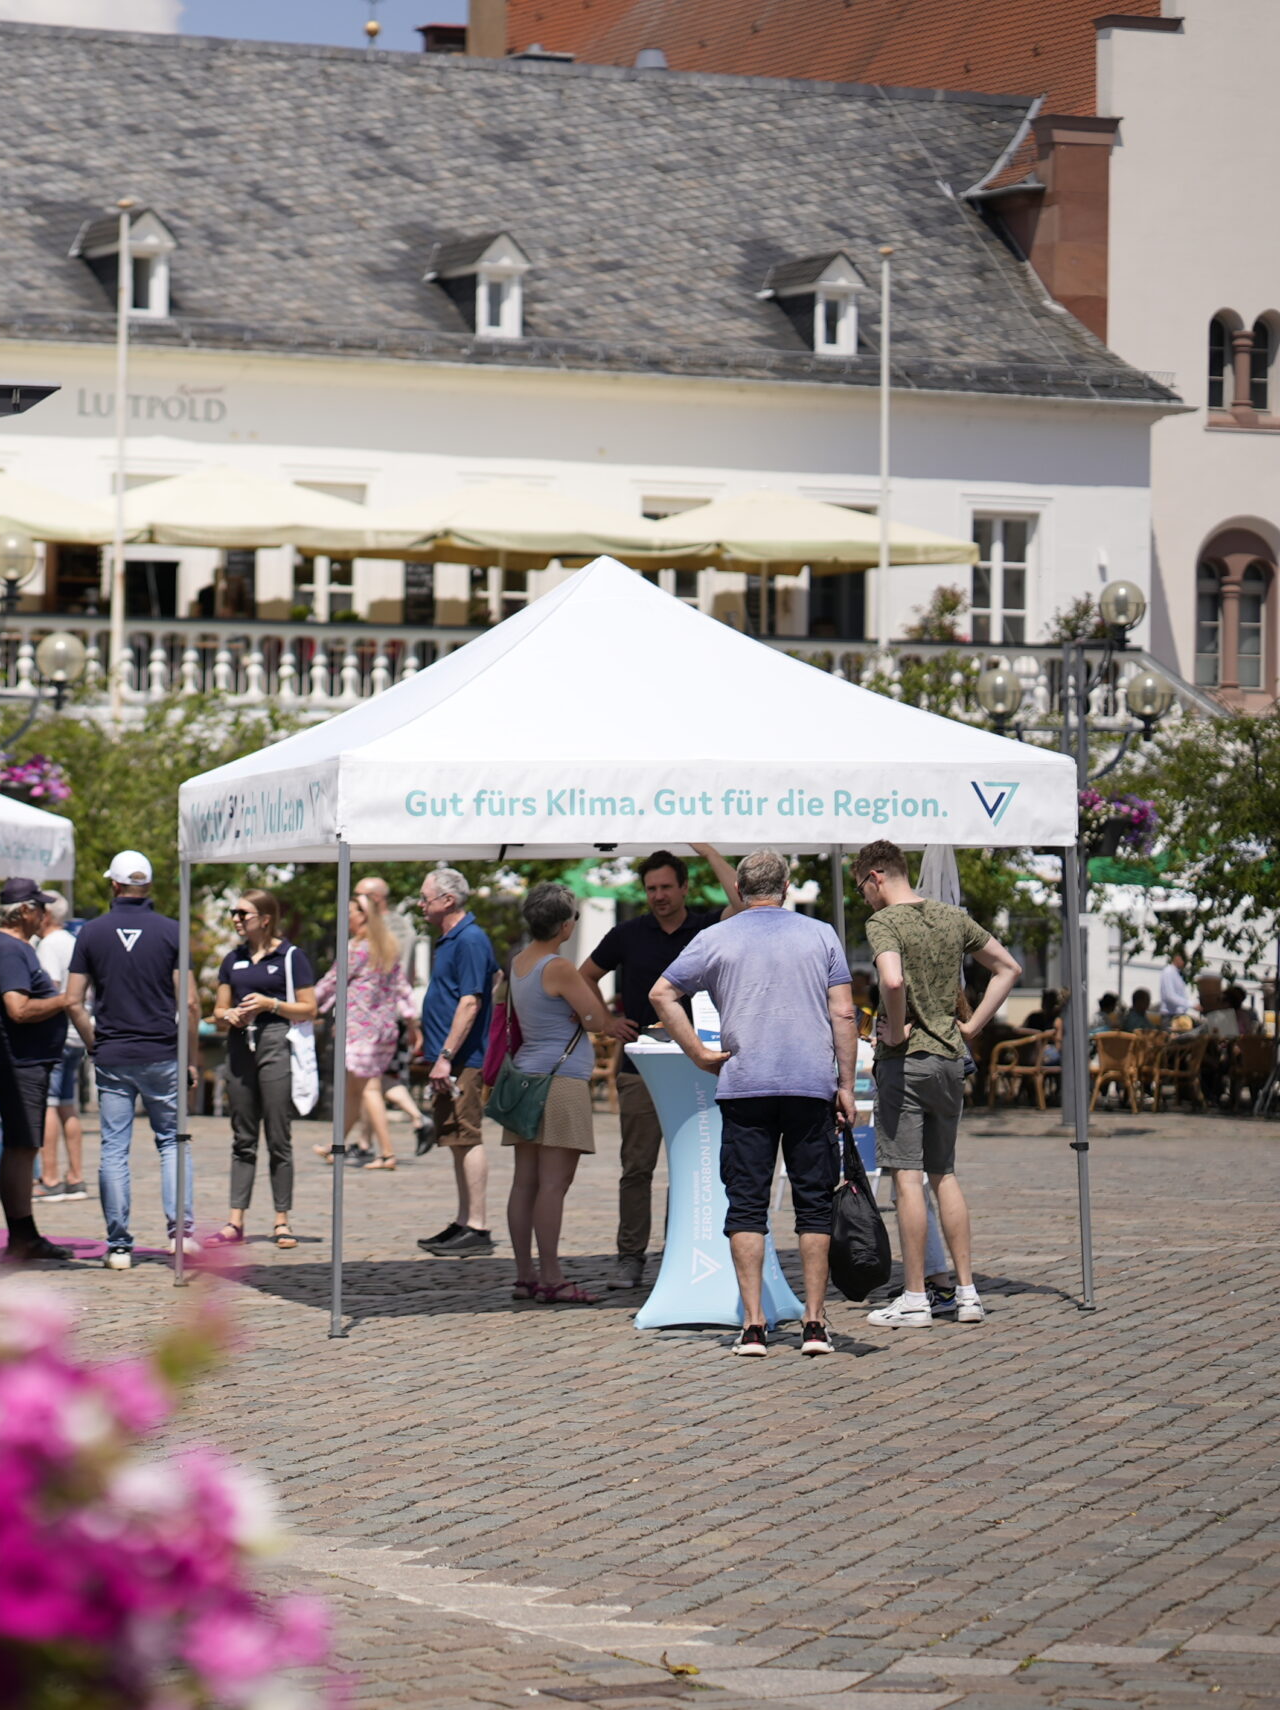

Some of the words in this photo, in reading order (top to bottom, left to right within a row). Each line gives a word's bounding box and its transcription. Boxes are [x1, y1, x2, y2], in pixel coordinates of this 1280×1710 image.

[77, 388, 227, 423] LUTPOLD
[261, 787, 305, 835] Vulcan
[404, 790, 465, 817] Gut
[472, 789, 537, 817] fürs
[546, 788, 645, 817] Klima.
[653, 788, 713, 816] Gut
[720, 788, 769, 817] für
[776, 788, 825, 817] die
[833, 789, 949, 825] Region.
[700, 1146, 713, 1202] CARBON
[701, 1205, 713, 1241] ZERO
